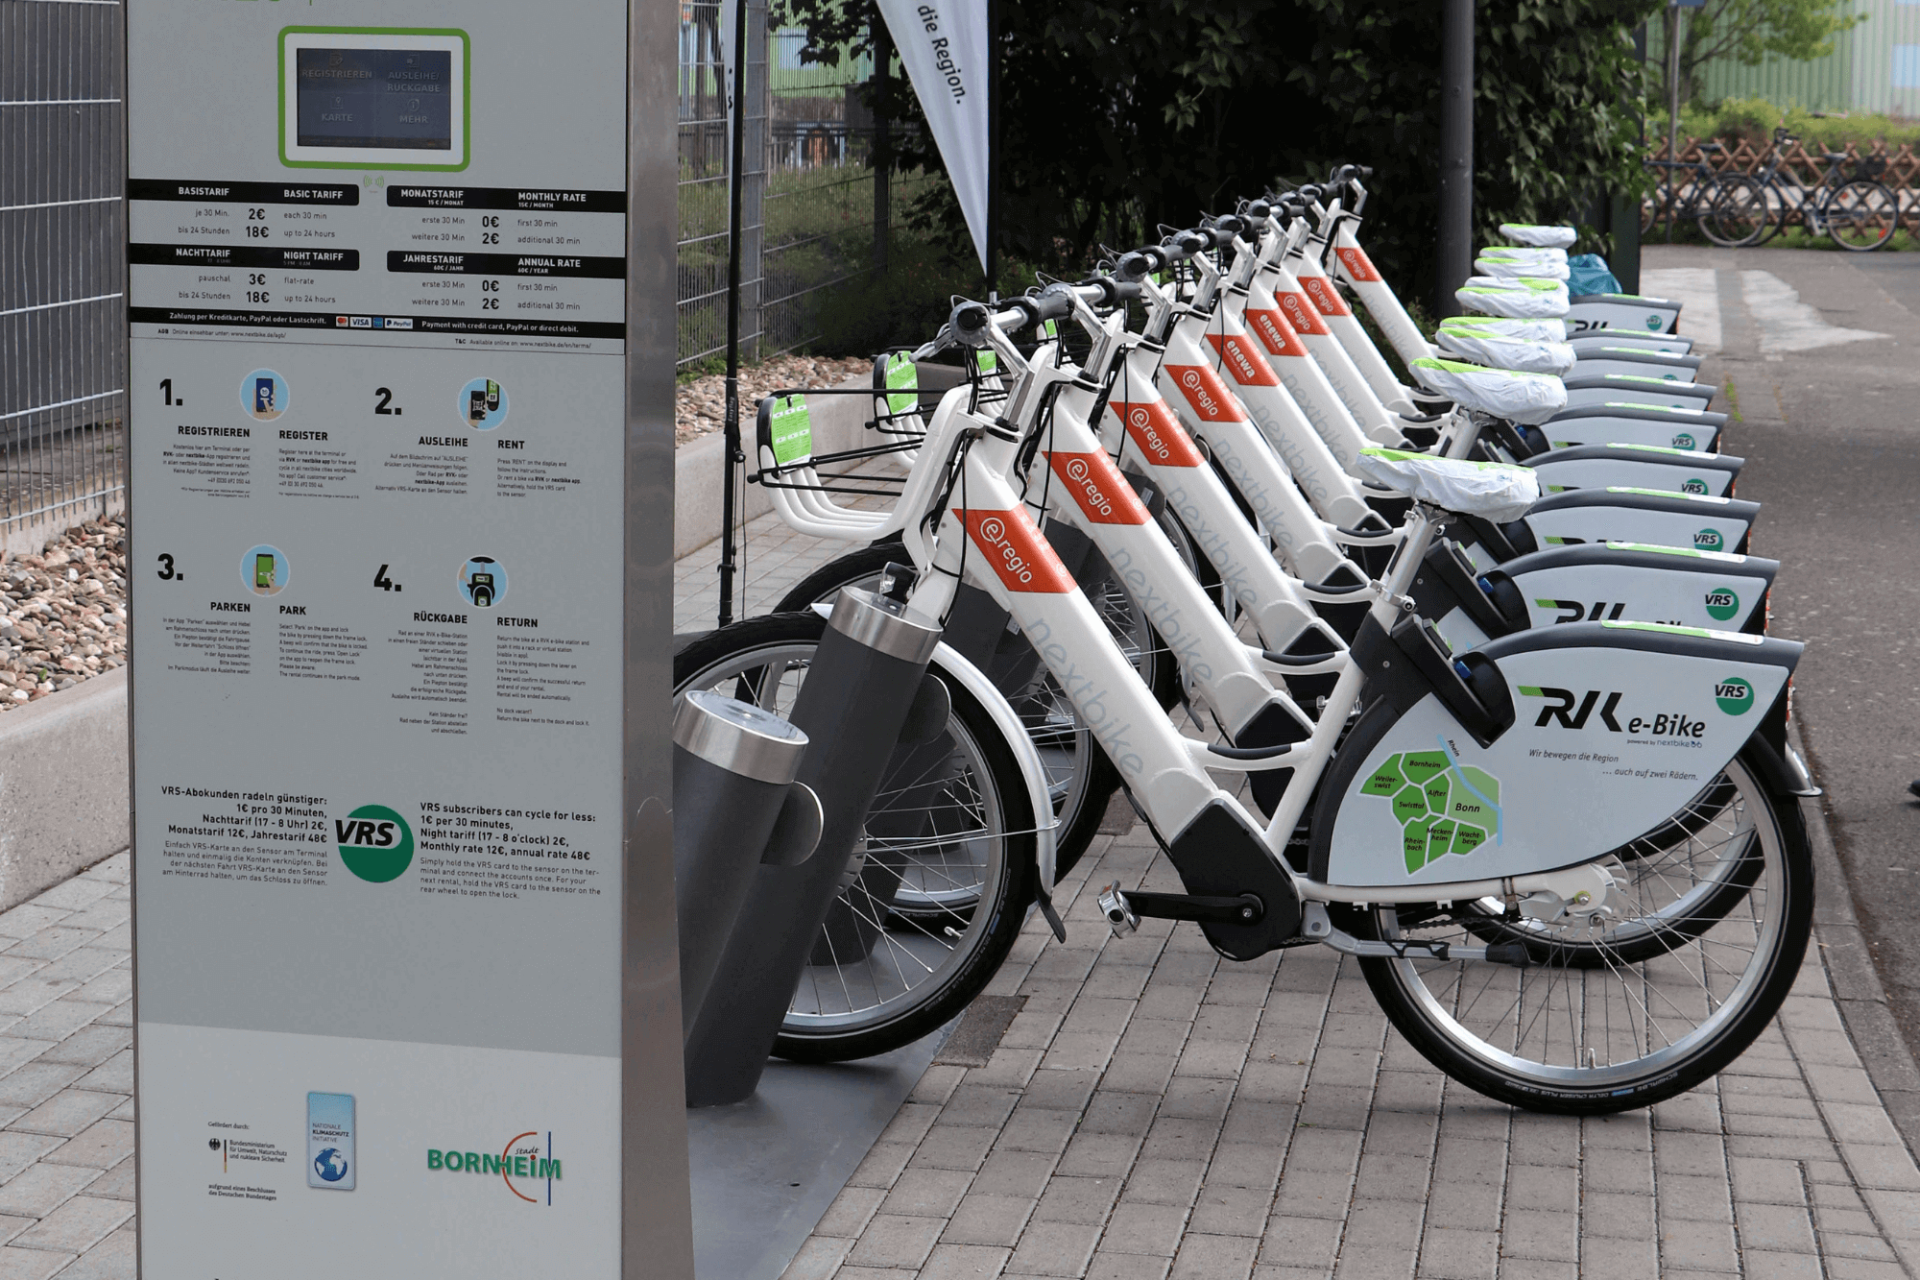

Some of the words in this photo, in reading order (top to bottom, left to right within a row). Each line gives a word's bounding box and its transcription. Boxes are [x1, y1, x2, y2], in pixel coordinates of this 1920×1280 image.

[918, 6, 938, 33] die
[932, 37, 966, 104] Region.
[178, 187, 229, 196] BASISTARIF
[284, 189, 310, 198] BASIC
[312, 190, 343, 199] TARIFF
[401, 189, 464, 198] MONATSTARIF
[518, 192, 561, 201] MONTHLY
[563, 193, 586, 202] RATE
[195, 210, 202, 218] je
[248, 208, 265, 220] 2€
[482, 216, 499, 228] 0€
[246, 226, 269, 238] 18€
[482, 232, 499, 245] 2€
[176, 248, 230, 257] NACHTTARIF
[284, 251, 311, 260] NIGHT
[312, 252, 343, 260] TARIFF
[403, 255, 464, 263] JAHRESTARIF
[518, 258, 556, 267] ANNUAL
[557, 259, 580, 268] RATE
[249, 273, 266, 285] 3€
[482, 280, 499, 292] 0€
[246, 291, 270, 303] 18€
[482, 298, 499, 310] 2€
[169, 312, 196, 321] Zahlung
[249, 315, 272, 323] PayPal
[1260, 314, 1286, 348] enewa
[1227, 340, 1255, 378] enewa
[160, 378, 183, 406] 1.
[1310, 348, 1367, 430] nextbike
[375, 387, 402, 415] 2.
[1283, 374, 1349, 468] nextbike
[178, 426, 250, 437] REGISTRIEREN
[279, 430, 328, 440] REGISTER
[419, 437, 468, 447] AUSLEIHE
[498, 440, 524, 449] RENT
[1672, 437, 1691, 447] VRS
[1254, 404, 1328, 500] nextbike
[1214, 438, 1294, 550] nextbike
[1682, 483, 1703, 493] VRS
[1693, 534, 1717, 544] VRS
[1168, 486, 1258, 608] nextbike
[157, 553, 183, 581] 3.
[374, 564, 402, 592] 4.
[1705, 594, 1731, 606] VRS
[210, 602, 250, 612] PARKEN
[280, 606, 306, 615] PARK
[414, 611, 467, 624] RÜCKGABE
[1111, 548, 1212, 683] nextbike
[497, 617, 538, 627] RETURN
[1715, 684, 1745, 698] VRS
[1026, 618, 1144, 778] nextbike
[1628, 714, 1705, 738] e-Bike
[1448, 740, 1460, 757] Rhein
[1657, 740, 1690, 748] nextbike
[1529, 749, 1542, 757] Wir
[1543, 750, 1576, 761] bewegen
[1578, 752, 1590, 760] die
[1592, 754, 1619, 763] Region
[1409, 760, 1440, 768] Bornheim
[1614, 768, 1633, 776] auch
[1635, 769, 1649, 778] auf
[1669, 770, 1698, 781] Rädern.
[162, 786, 240, 799] VRS-Abokunden
[242, 792, 274, 801] radeln
[277, 794, 327, 806] günstiger:
[237, 803, 248, 813] 1€
[251, 806, 268, 814] pro
[271, 805, 282, 815] 30
[285, 807, 327, 818] Minuten,
[420, 802, 440, 812] VRS
[443, 805, 502, 816] subscribers
[525, 810, 551, 820] cycle
[554, 811, 569, 820] for
[572, 812, 595, 822] less:
[1455, 803, 1480, 813] Bonn
[203, 814, 252, 825] Nachttarif
[278, 819, 284, 828] 8
[311, 821, 327, 832] 2€,
[421, 815, 432, 824] 1€
[436, 818, 453, 826] per
[456, 817, 467, 827] 30
[470, 819, 513, 830] minutes,
[168, 825, 224, 836] Monatstarif
[228, 828, 248, 839] 12€,
[251, 830, 305, 841] Jahrestarif
[308, 834, 327, 843] 48€
[335, 820, 394, 846] VRS
[420, 828, 447, 839] Night
[450, 830, 475, 840] tariff
[502, 833, 509, 842] 8
[553, 836, 569, 847] 2€,
[420, 841, 460, 853] Monthly
[463, 845, 483, 853] rate
[487, 845, 507, 856] 12€,
[510, 849, 544, 857] annual
[547, 851, 568, 859] rate
[571, 851, 590, 860] 48€
